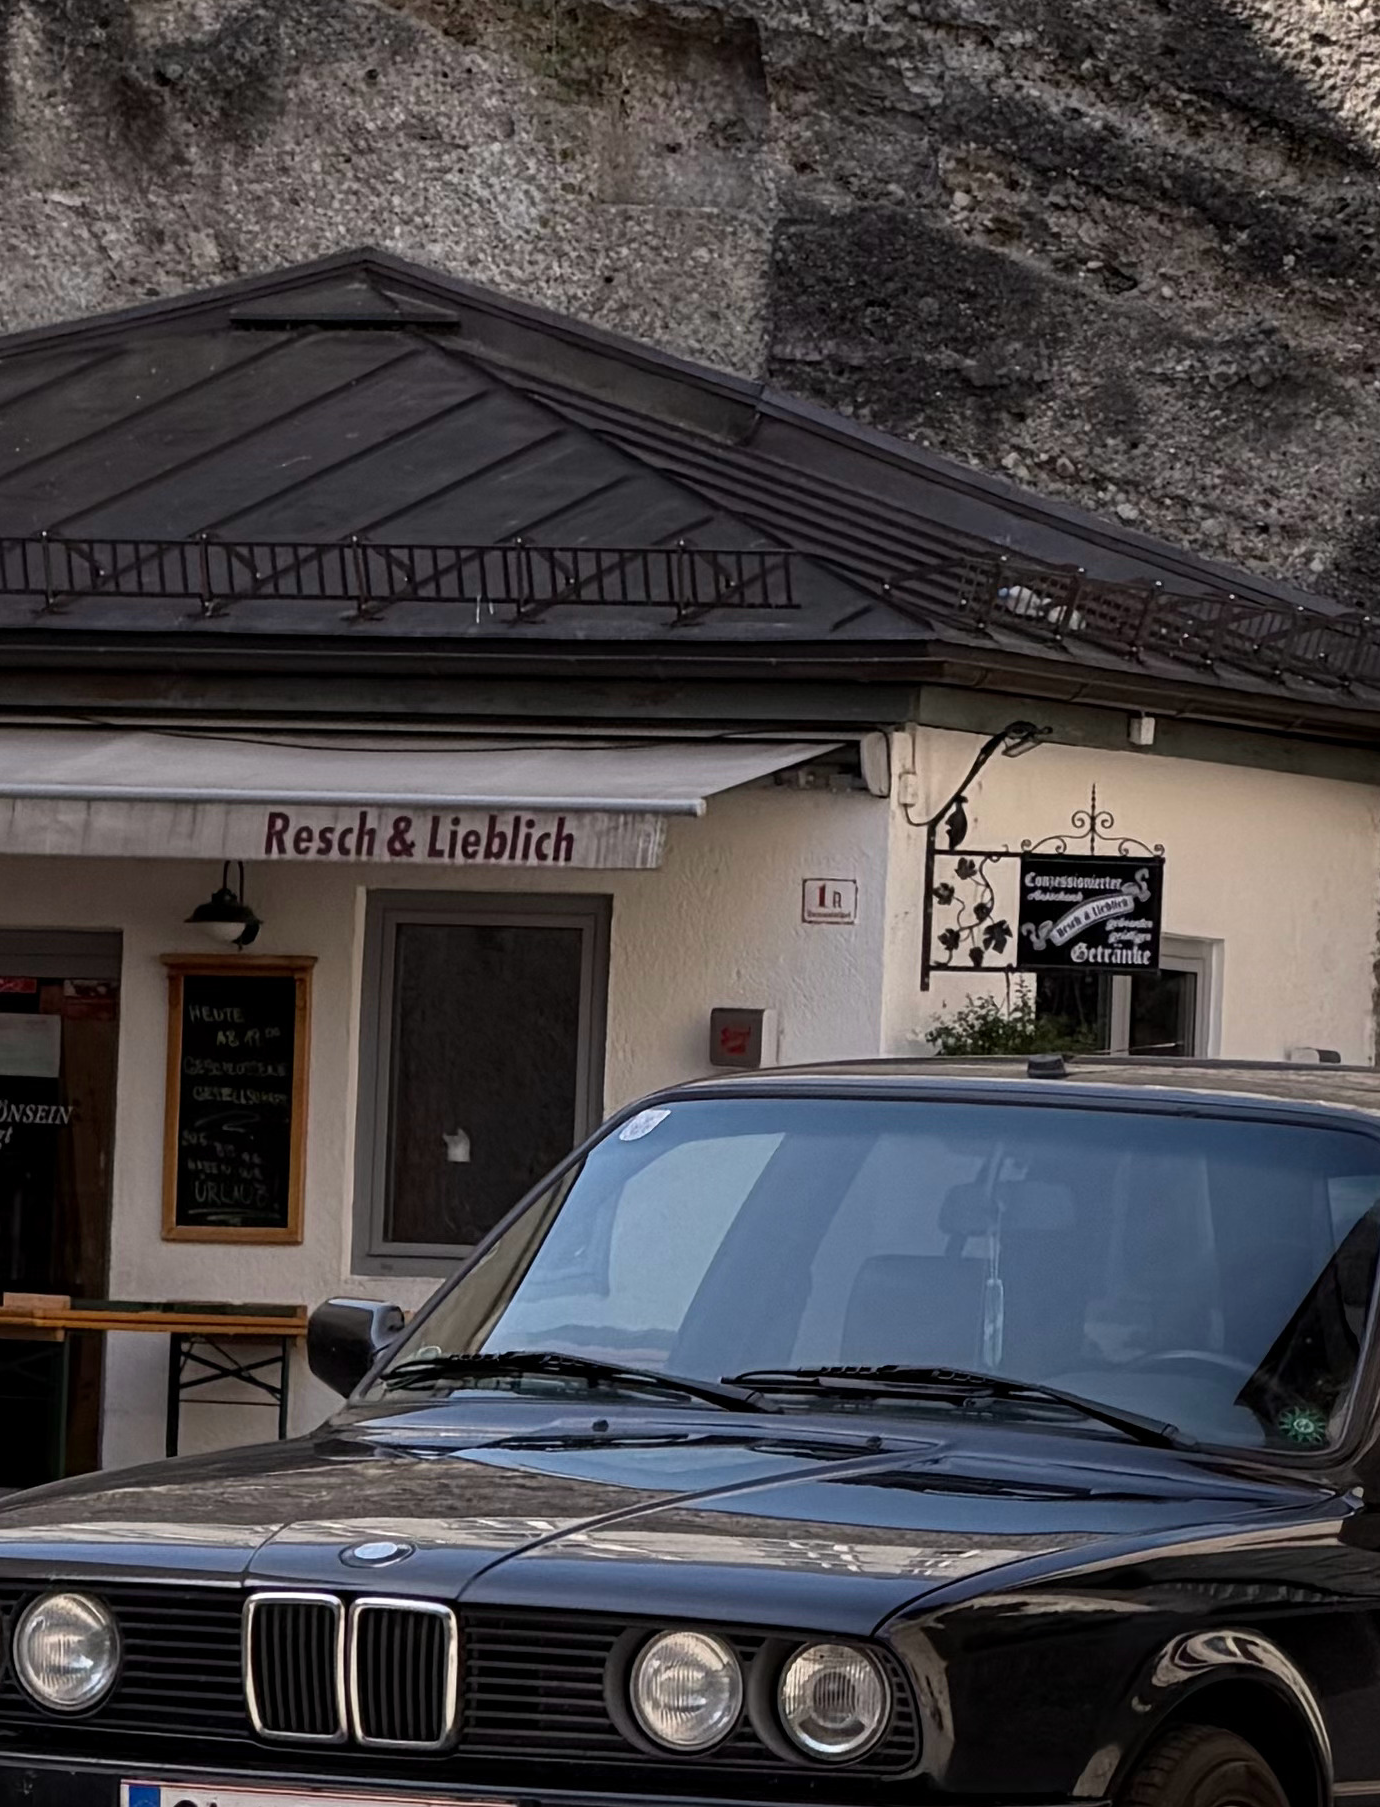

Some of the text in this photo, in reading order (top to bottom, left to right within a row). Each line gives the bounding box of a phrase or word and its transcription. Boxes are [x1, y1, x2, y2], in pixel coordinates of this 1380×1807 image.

[264, 810, 576, 863] Resch & Lieblich
